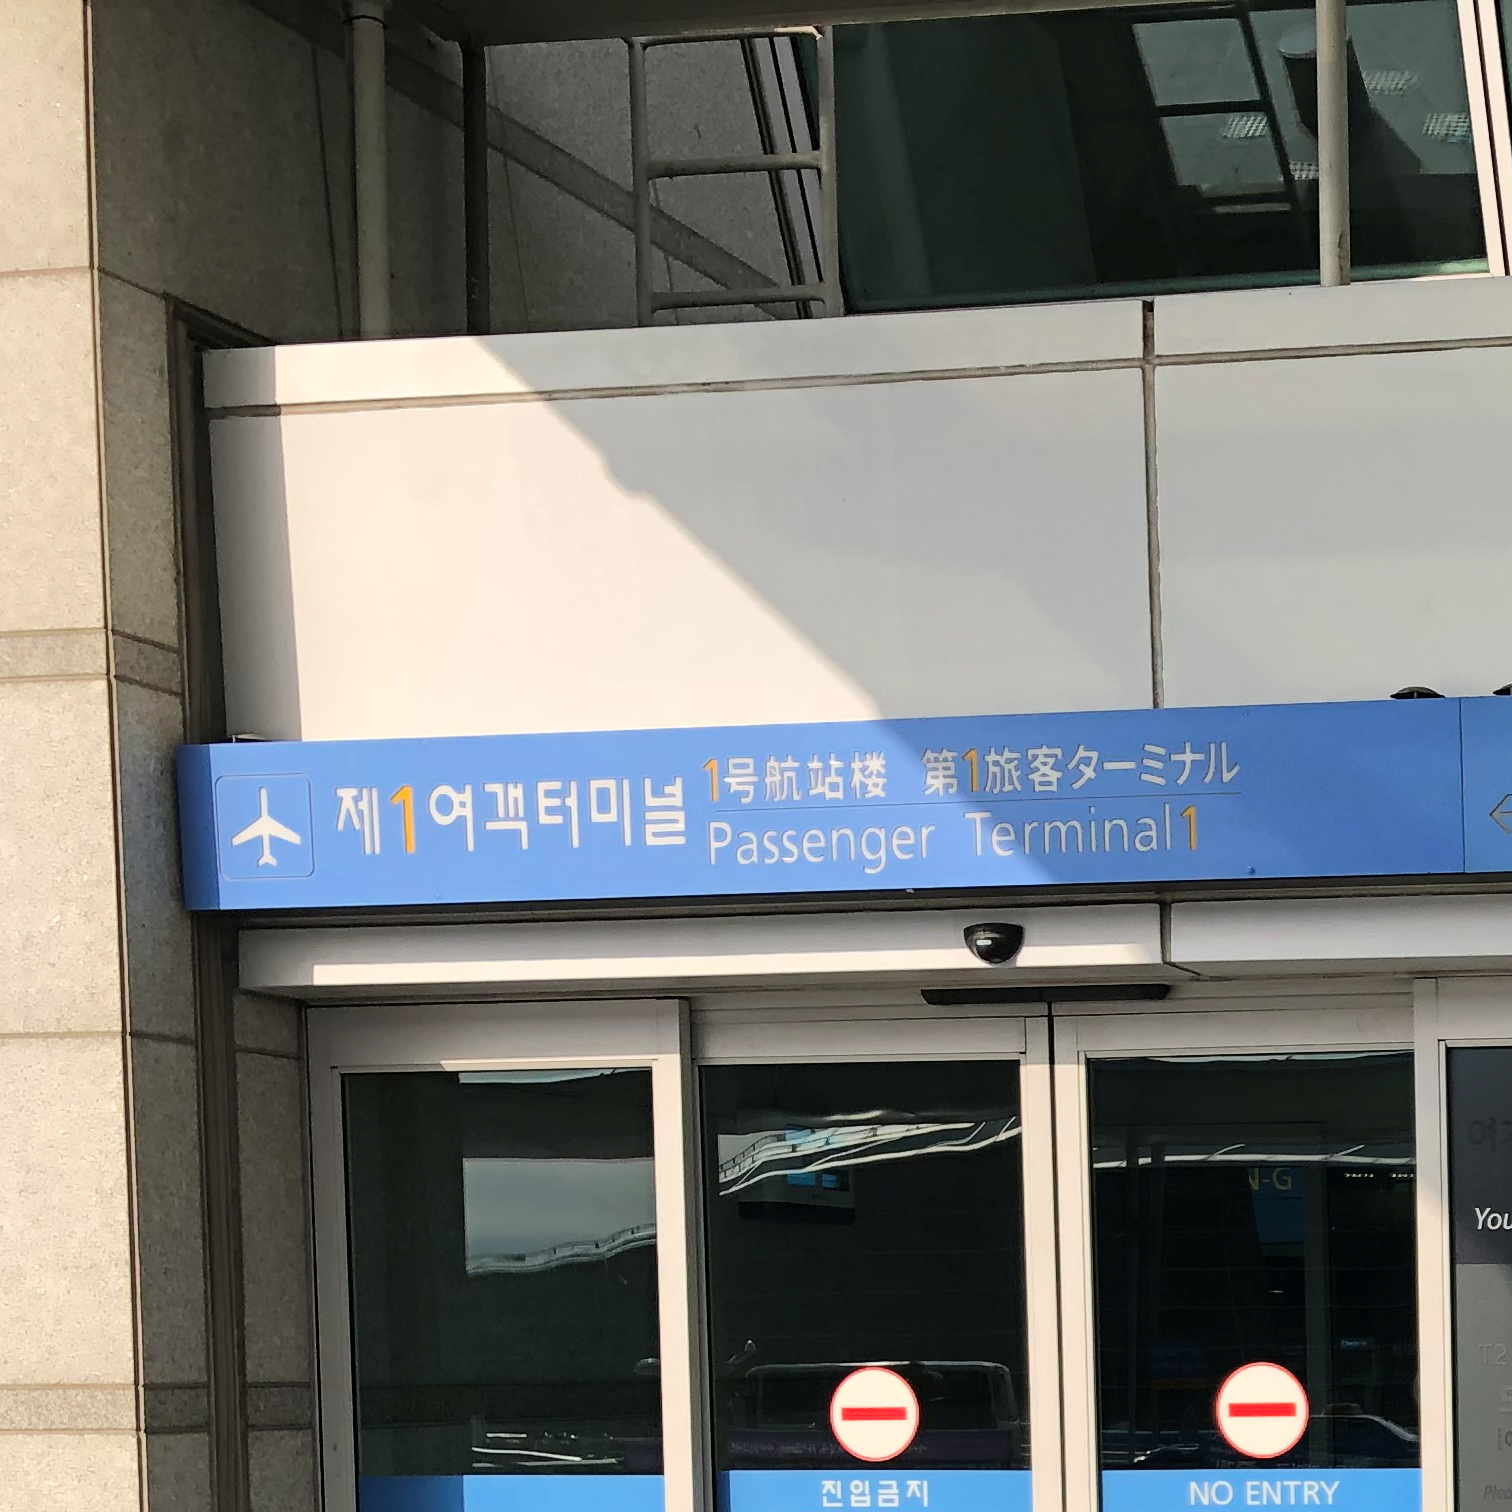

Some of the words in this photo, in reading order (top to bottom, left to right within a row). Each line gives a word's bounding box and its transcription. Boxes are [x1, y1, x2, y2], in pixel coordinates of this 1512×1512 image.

[703, 749, 888, 804] 1号航站楼
[922, 741, 1241, 798] 第1旅客ターミナル
[335, 776, 687, 855] 제1여객터미널
[708, 819, 935, 875] Passenger
[820, 1478, 930, 1509] 진입금지
[1189, 1480, 1234, 1507] NO
[1244, 1480, 1340, 1507] ENTRY
